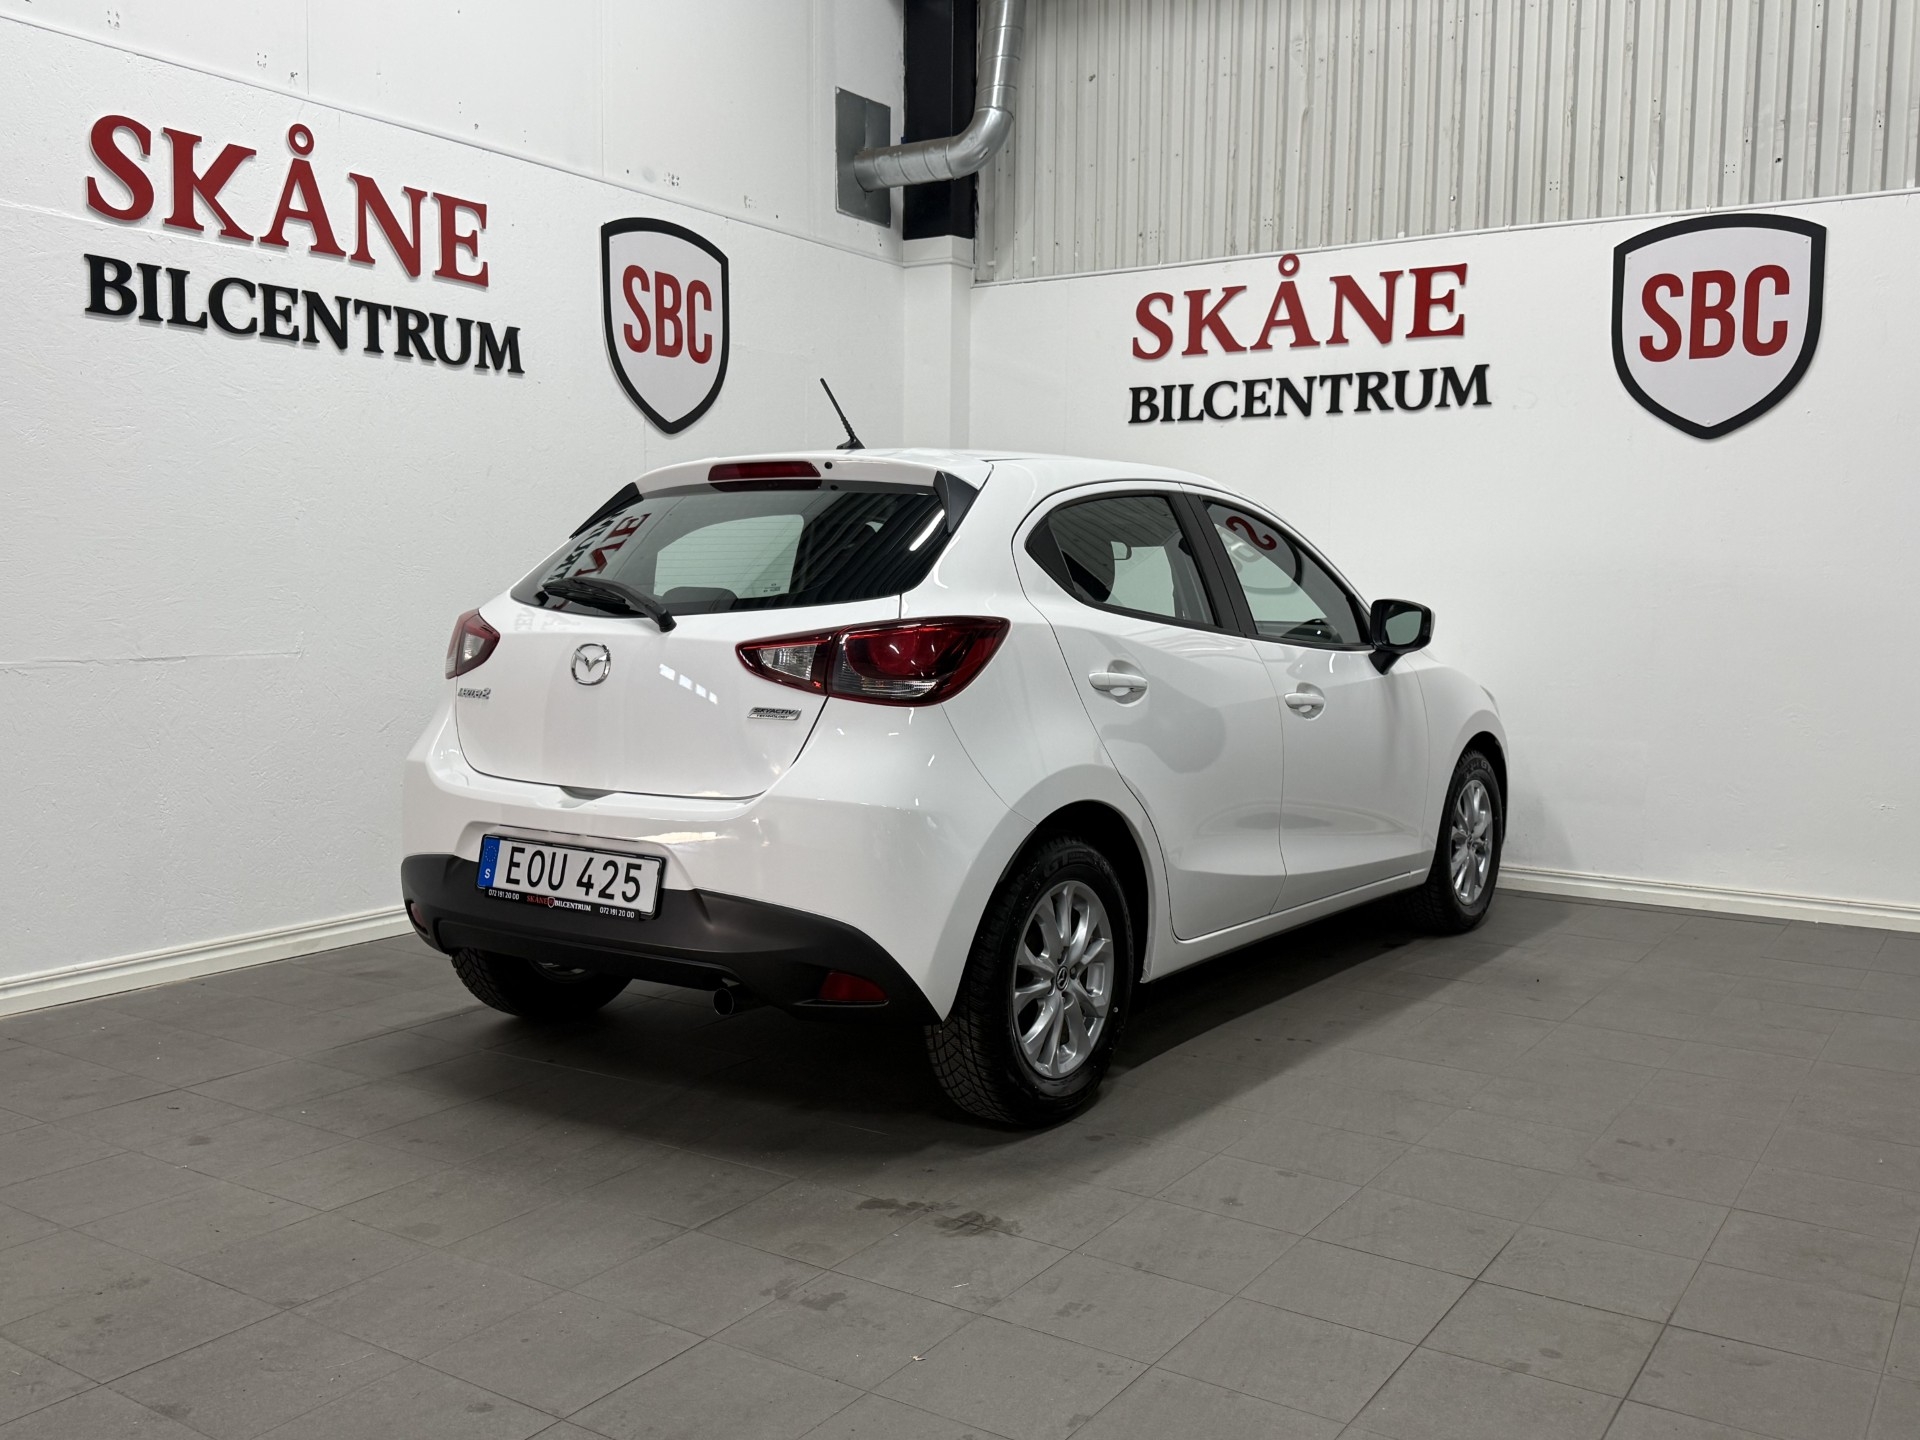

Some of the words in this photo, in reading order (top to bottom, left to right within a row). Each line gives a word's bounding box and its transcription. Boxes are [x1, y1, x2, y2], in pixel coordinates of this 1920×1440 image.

[86, 115, 490, 288] SKÅNE
[84, 253, 526, 376] BILCENTRUM
[622, 264, 714, 364] SBC
[1132, 254, 1469, 362] SKÅNE
[1640, 264, 1793, 363] SBC
[1128, 364, 1492, 425] BILCENTRUM
[484, 868, 491, 879] S
[505, 846, 568, 891] EOU
[576, 857, 642, 903] 425
[554, 900, 592, 911] BILCENTRUM
[599, 906, 609, 915] 072
[618, 909, 626, 917] 20
[626, 911, 635, 919] 00
